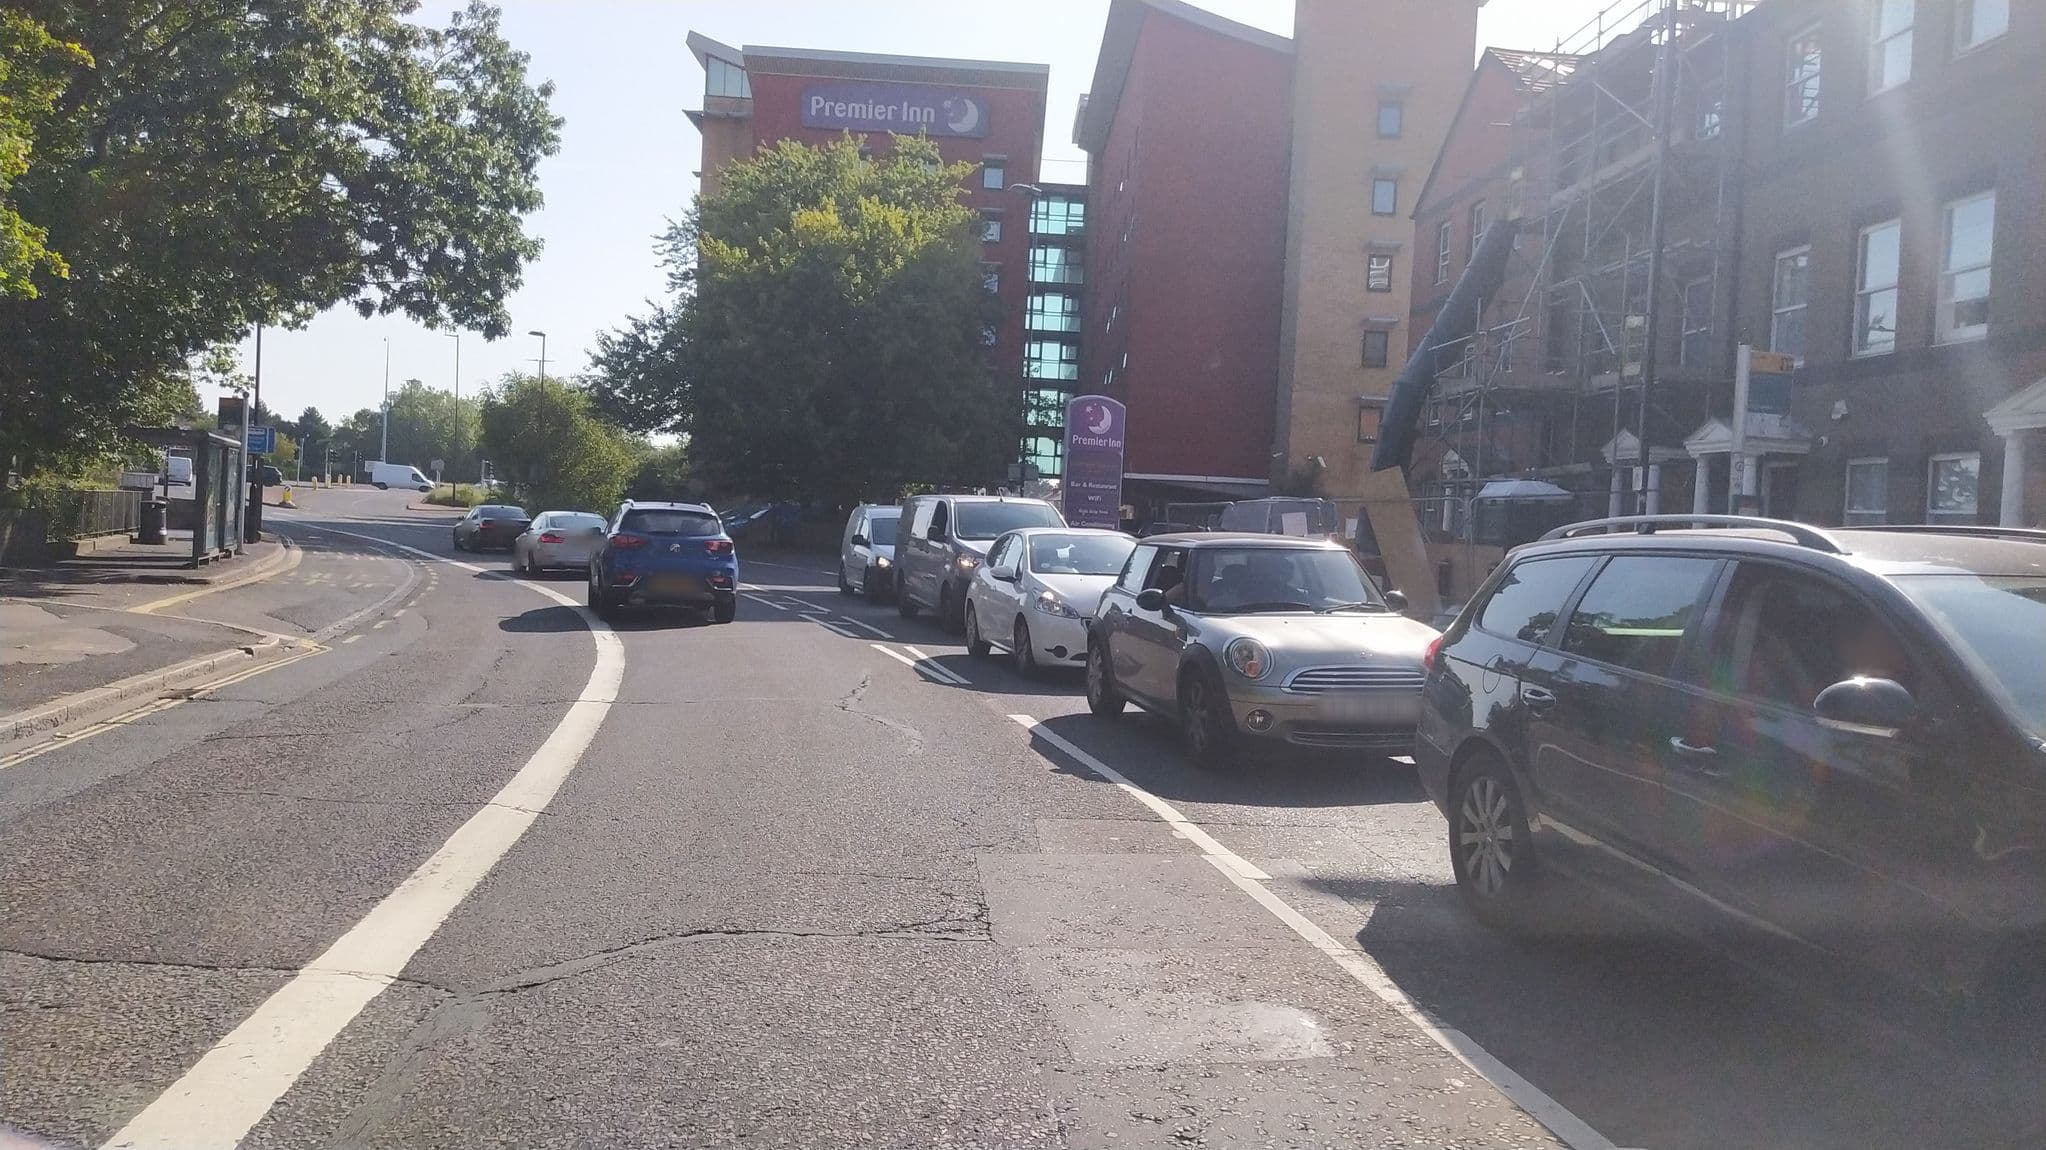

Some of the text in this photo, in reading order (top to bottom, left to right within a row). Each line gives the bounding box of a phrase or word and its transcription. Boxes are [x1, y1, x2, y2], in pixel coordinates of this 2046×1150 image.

[811, 95, 936, 123] Premier Inn
[1072, 434, 1122, 448] Premier Inn
